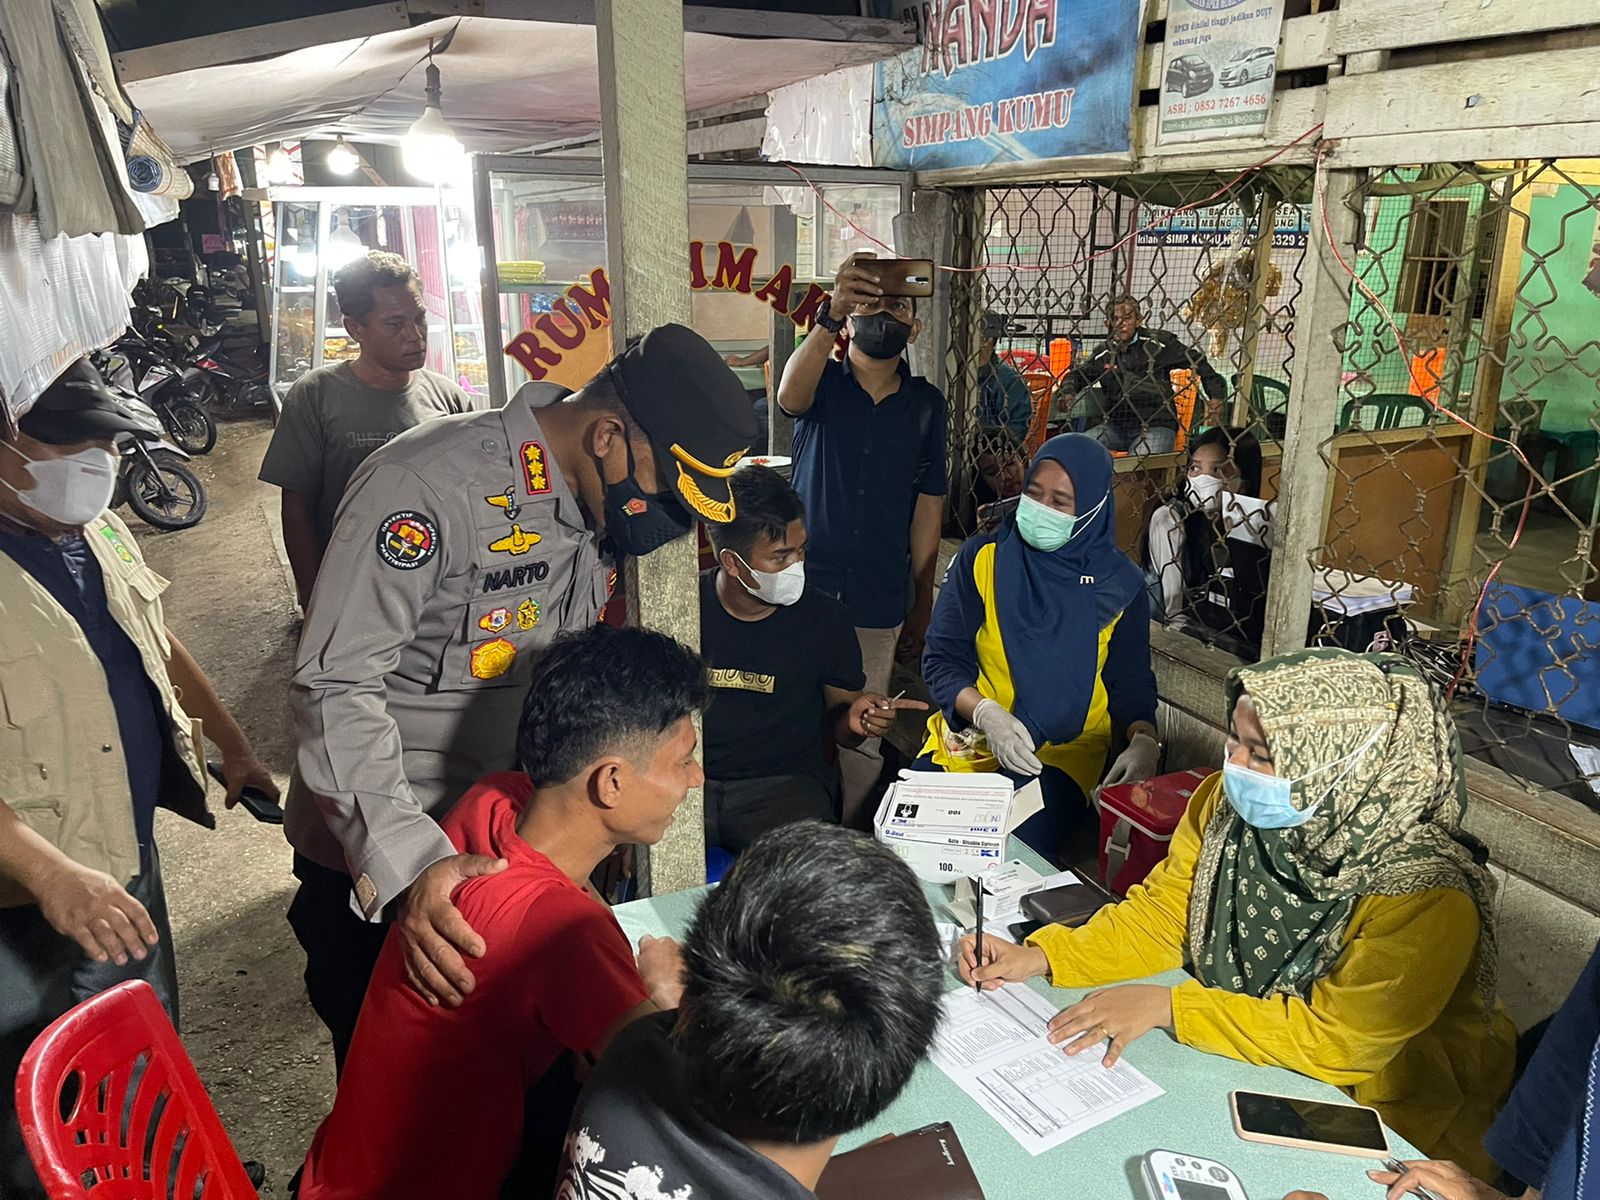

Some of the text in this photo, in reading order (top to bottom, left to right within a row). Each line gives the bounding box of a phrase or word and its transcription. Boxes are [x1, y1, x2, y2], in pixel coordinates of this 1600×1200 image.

[902, 87, 1076, 149] SIMPANG KUMU
[1167, 104, 1187, 116] ASRI
[1194, 99, 1217, 113] 0852
[1219, 96, 1241, 109] 7267
[1243, 94, 1267, 106] 4656
[483, 560, 549, 593] NARTO
[938, 862, 953, 872] 100
